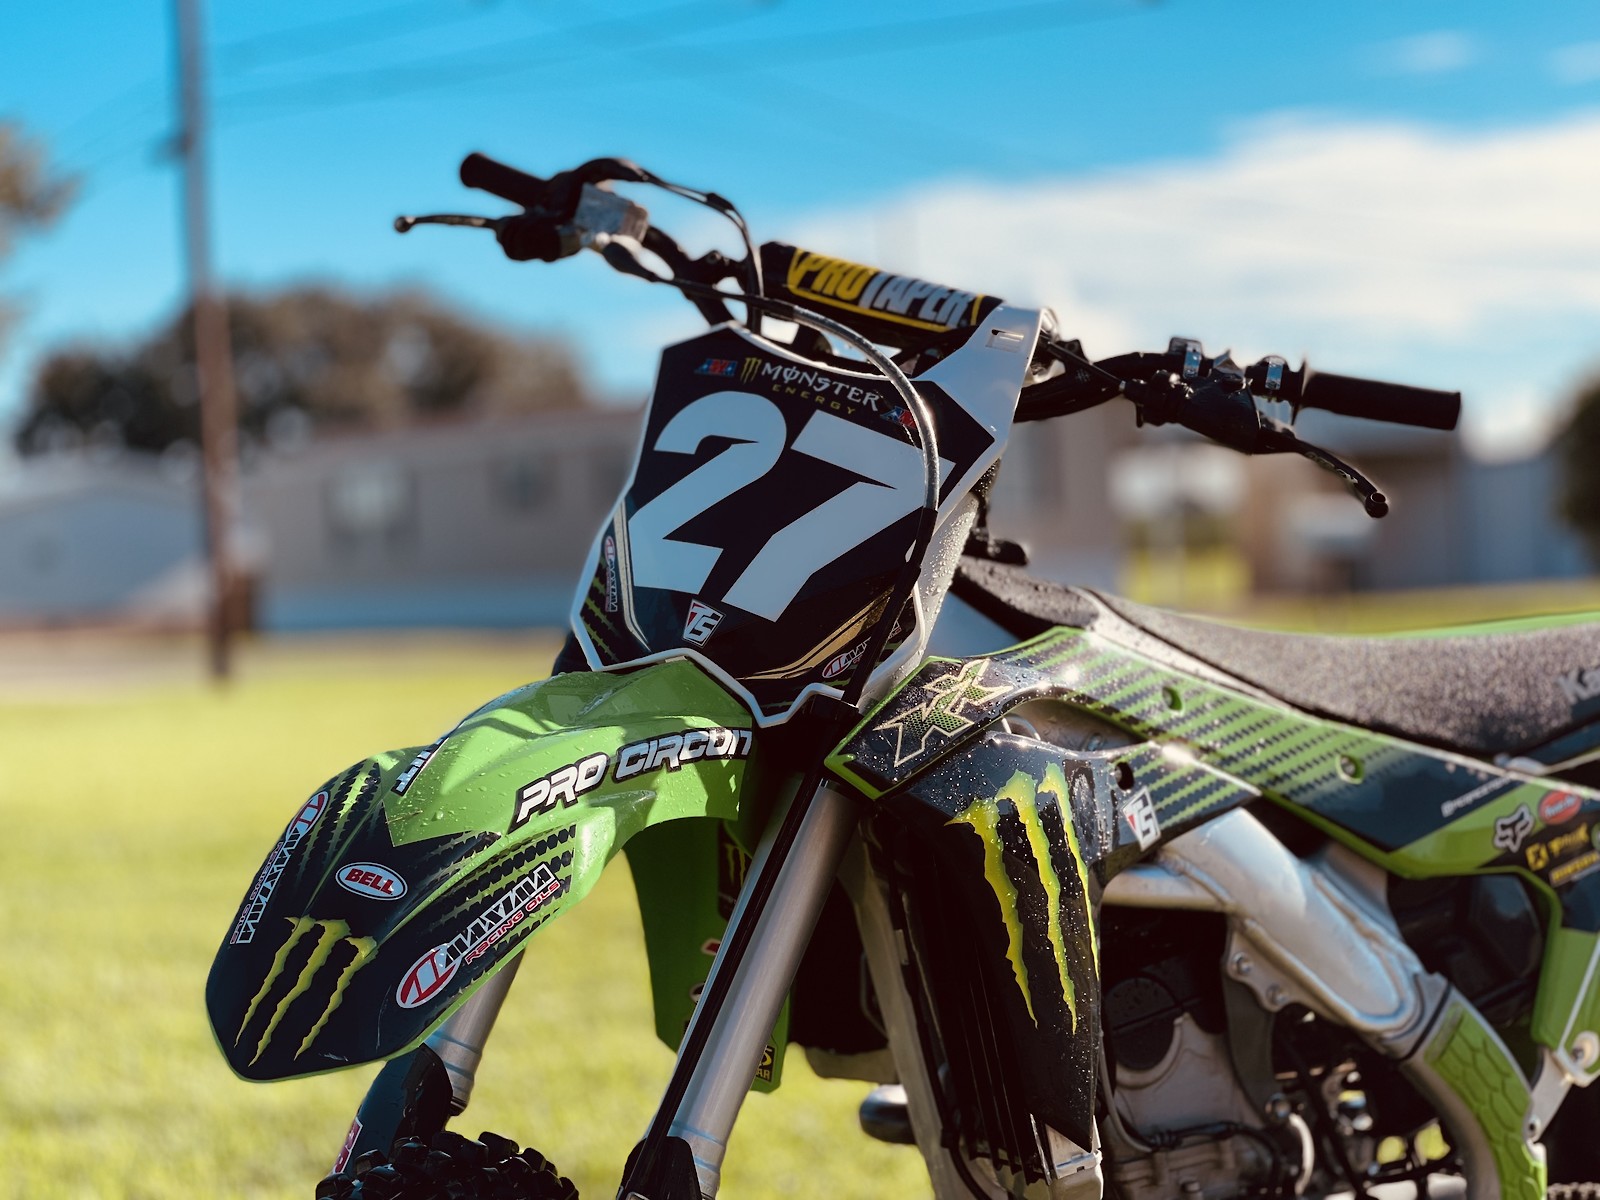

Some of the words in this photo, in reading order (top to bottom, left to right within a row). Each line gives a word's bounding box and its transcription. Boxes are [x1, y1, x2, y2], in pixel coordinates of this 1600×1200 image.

[772, 383, 856, 415] ENERGY
[628, 391, 956, 622] 27
[517, 754, 608, 823] PRO
[616, 729, 752, 779] CIRCUIT
[345, 868, 393, 895] BELL
[465, 910, 524, 964] RACING
[526, 881, 560, 911] OILS
